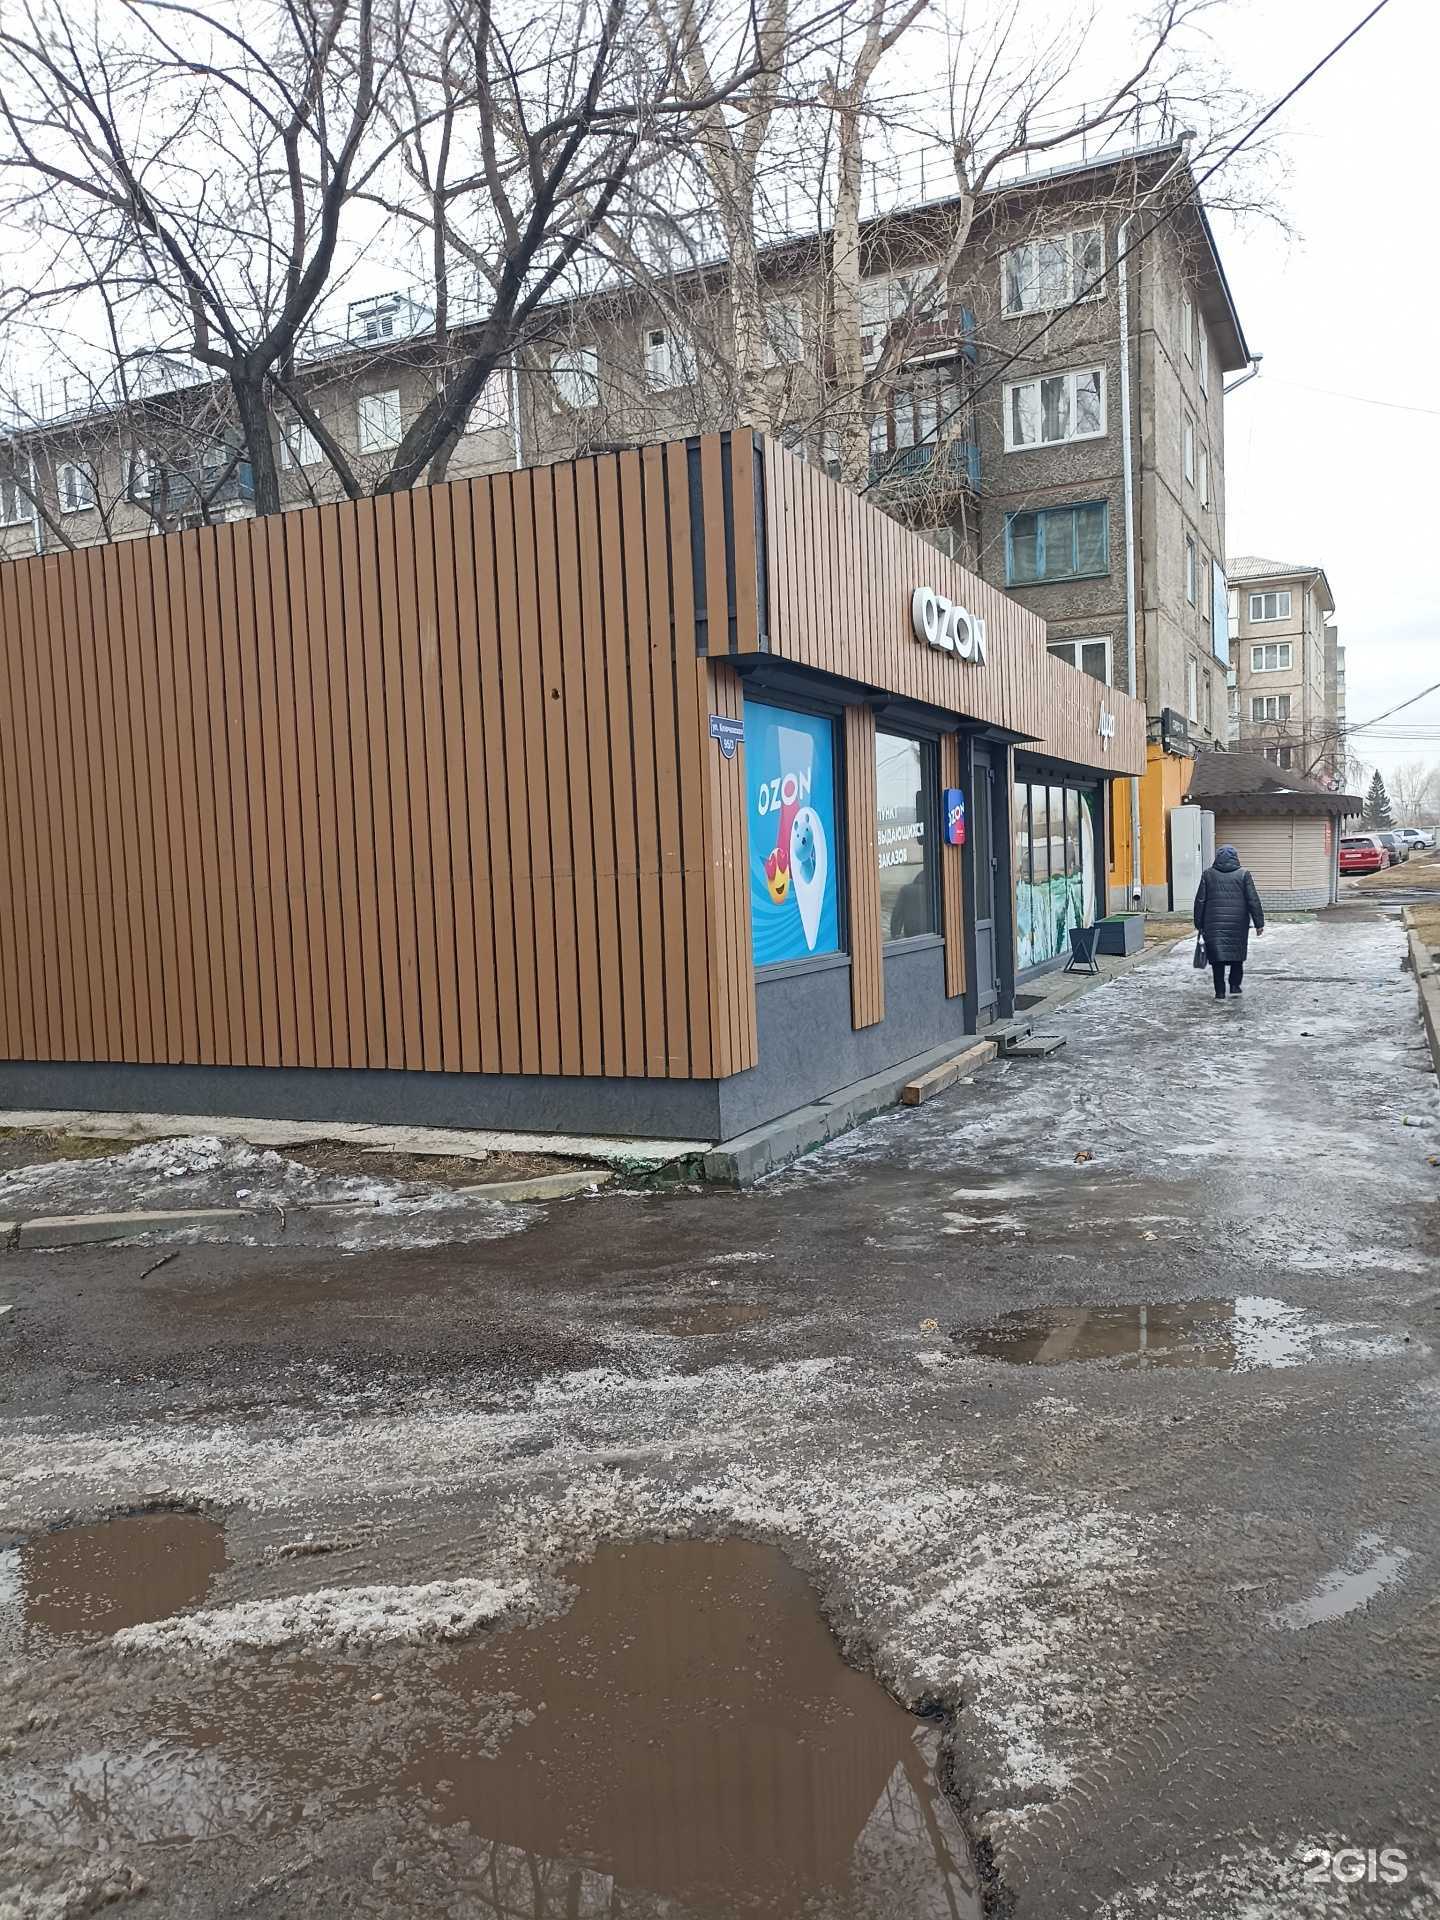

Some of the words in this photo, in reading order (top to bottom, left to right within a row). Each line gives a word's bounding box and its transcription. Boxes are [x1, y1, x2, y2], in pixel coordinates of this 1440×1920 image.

[912, 586, 987, 667] OZON
[758, 766, 811, 816] OZON
[877, 822, 924, 846] ВЫДАЮЩИХСЯ
[878, 848, 908, 869] ЗАКАЗОВ
